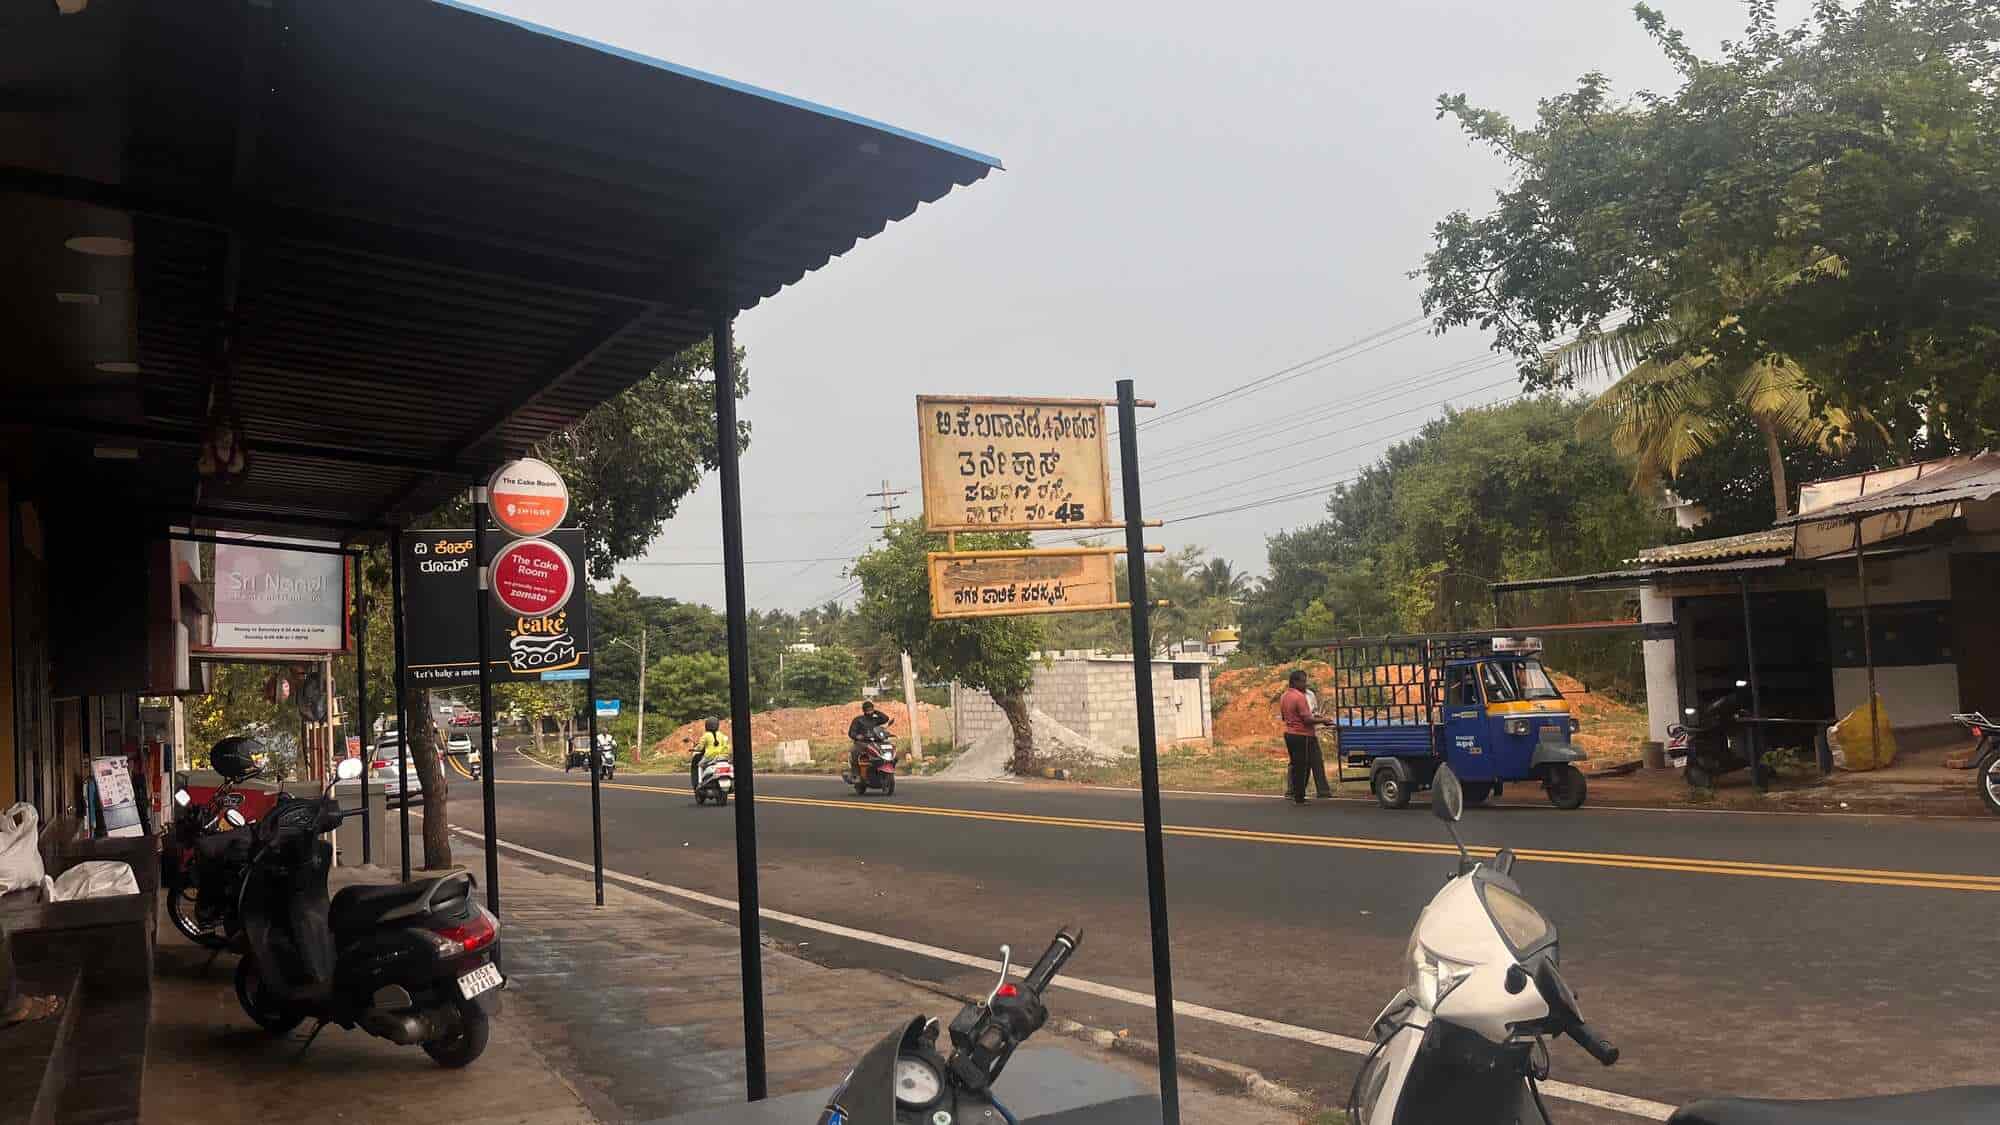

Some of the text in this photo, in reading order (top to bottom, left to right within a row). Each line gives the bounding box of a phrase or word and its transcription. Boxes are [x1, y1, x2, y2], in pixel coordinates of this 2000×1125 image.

[503, 477, 557, 487] The Cake Room
[414, 539, 473, 555] ದಿ ಕೇಕ್
[420, 558, 469, 573] ರೂಮ್
[511, 553, 560, 571] The Cake
[518, 564, 549, 579] Room
[231, 571, 328, 593] Sri Nandi
[509, 588, 548, 602] zomato
[517, 615, 566, 636] Cake
[511, 646, 576, 670] ROOM
